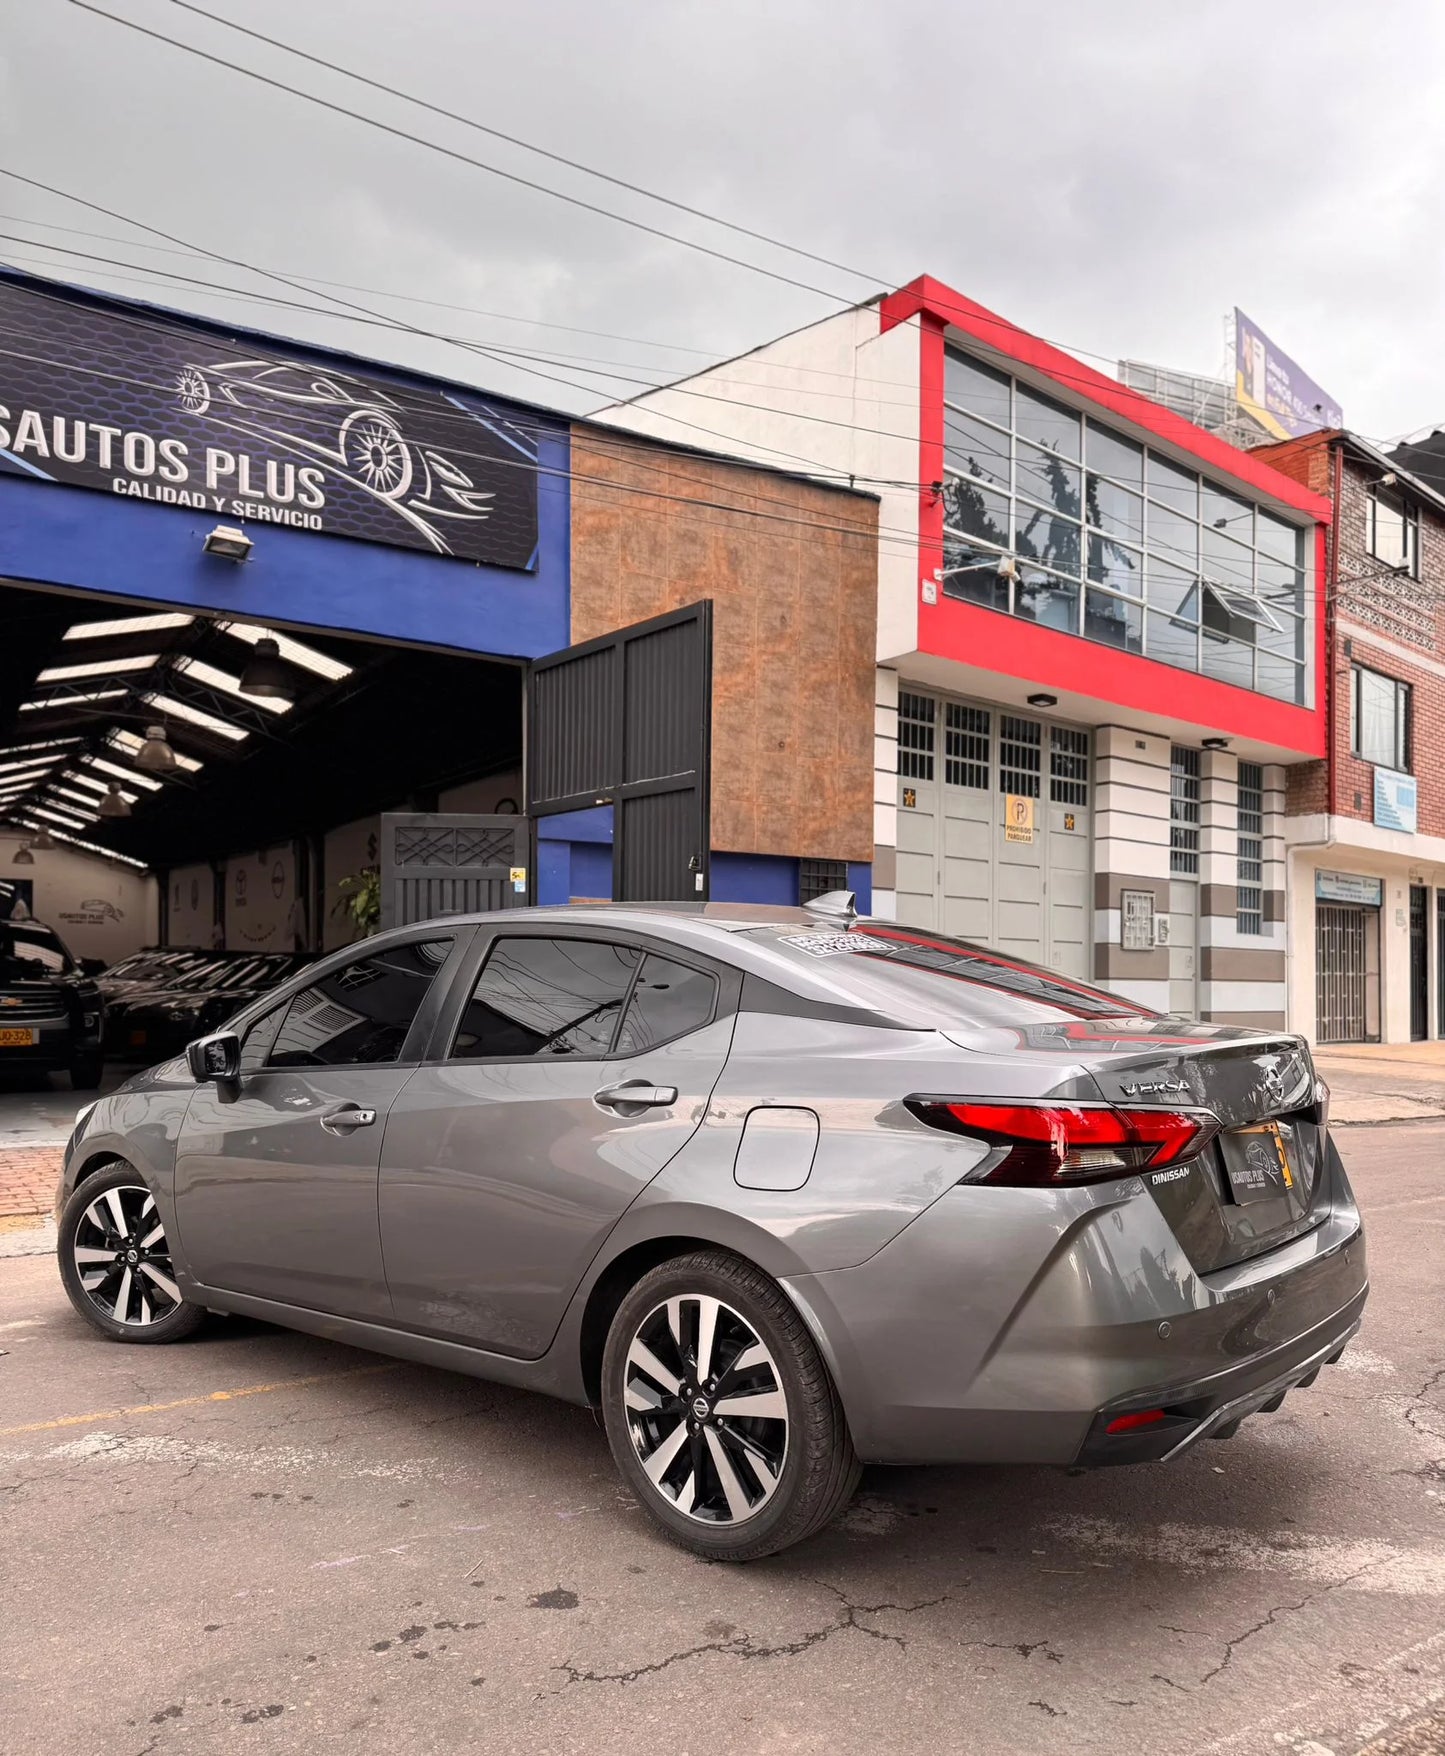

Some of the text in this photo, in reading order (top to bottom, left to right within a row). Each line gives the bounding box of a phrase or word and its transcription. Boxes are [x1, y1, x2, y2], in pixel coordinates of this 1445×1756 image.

[206, 447, 326, 509] PLUS
[113, 477, 323, 530] CALIDAD Y SERVICIO
[1119, 1080, 1191, 1097] VERSA
[1151, 1166, 1191, 1186] DINISSAN
